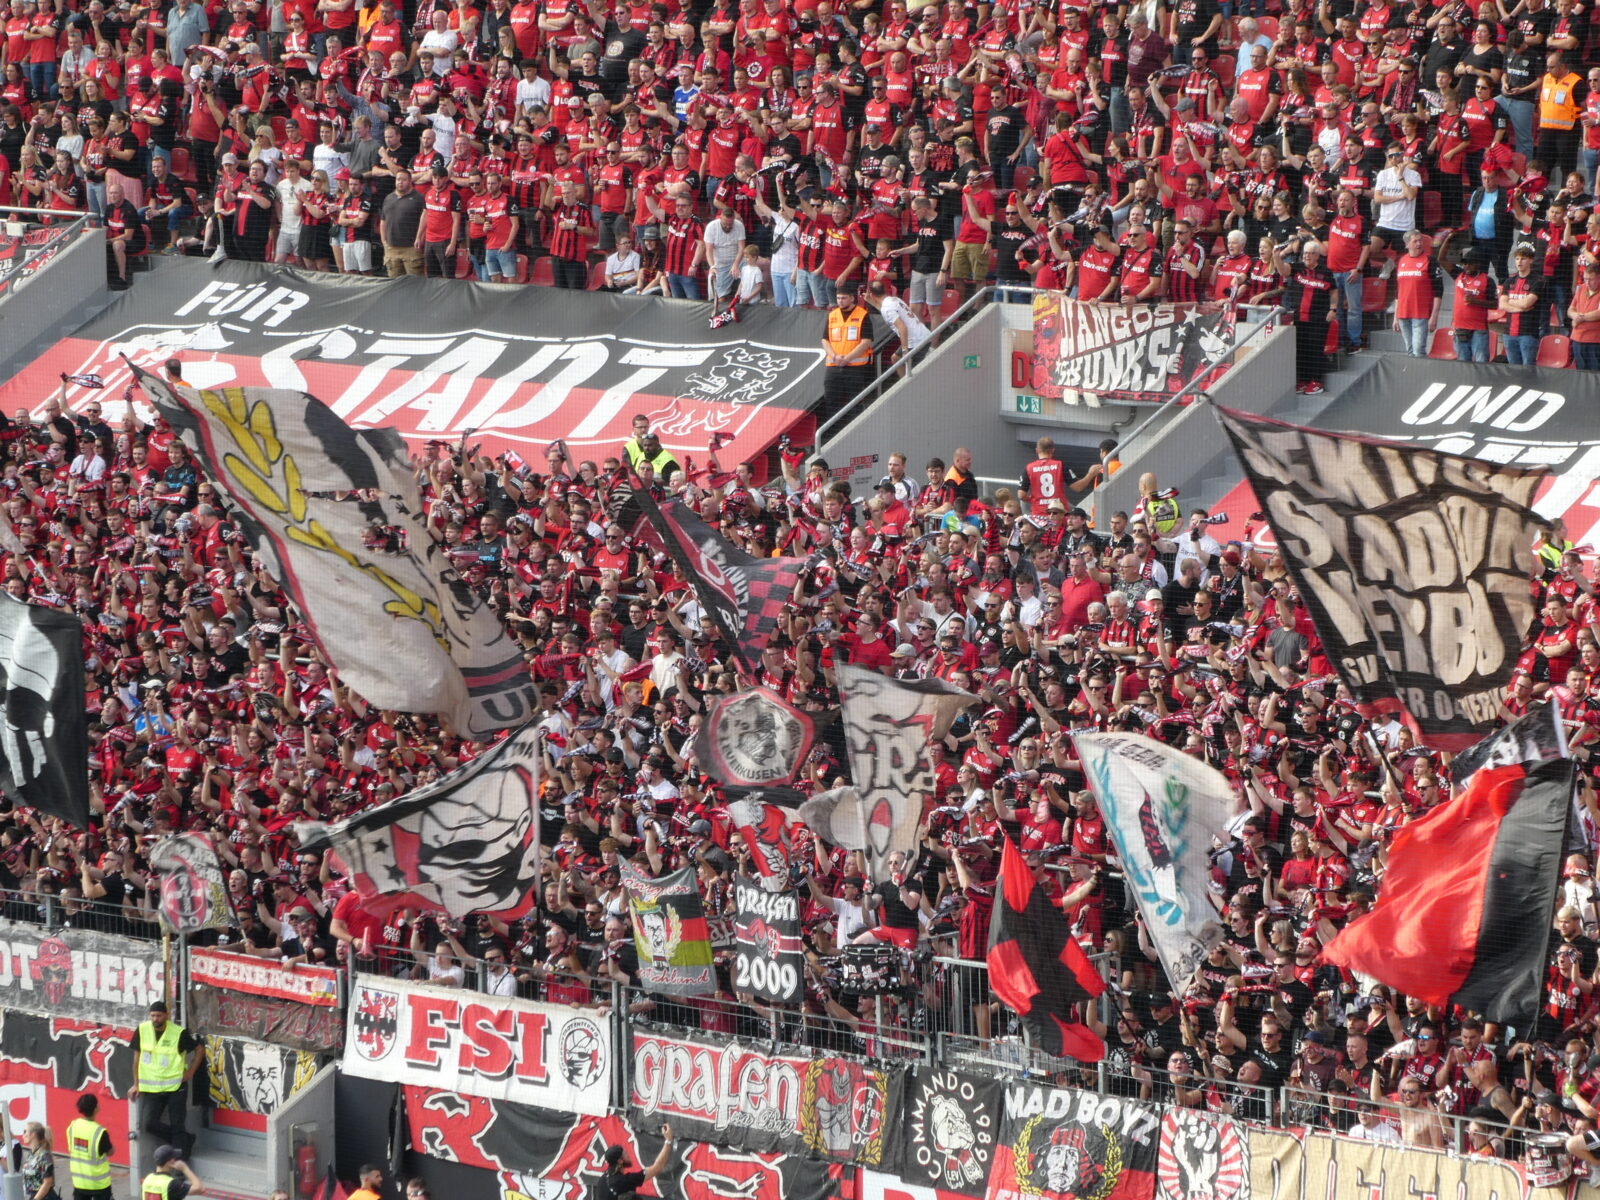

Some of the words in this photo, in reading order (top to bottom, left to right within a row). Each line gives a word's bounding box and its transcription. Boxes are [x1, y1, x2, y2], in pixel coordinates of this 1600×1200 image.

[174, 280, 309, 327] FÜR
[261, 329, 710, 438] STADT
[1401, 382, 1565, 431] UND
[1040, 472, 1055, 497] 8
[736, 953, 798, 1000] 2009
[405, 994, 551, 1086] FSI
[913, 1072, 975, 1179] COMMANDO
[972, 1101, 993, 1163] 1989
